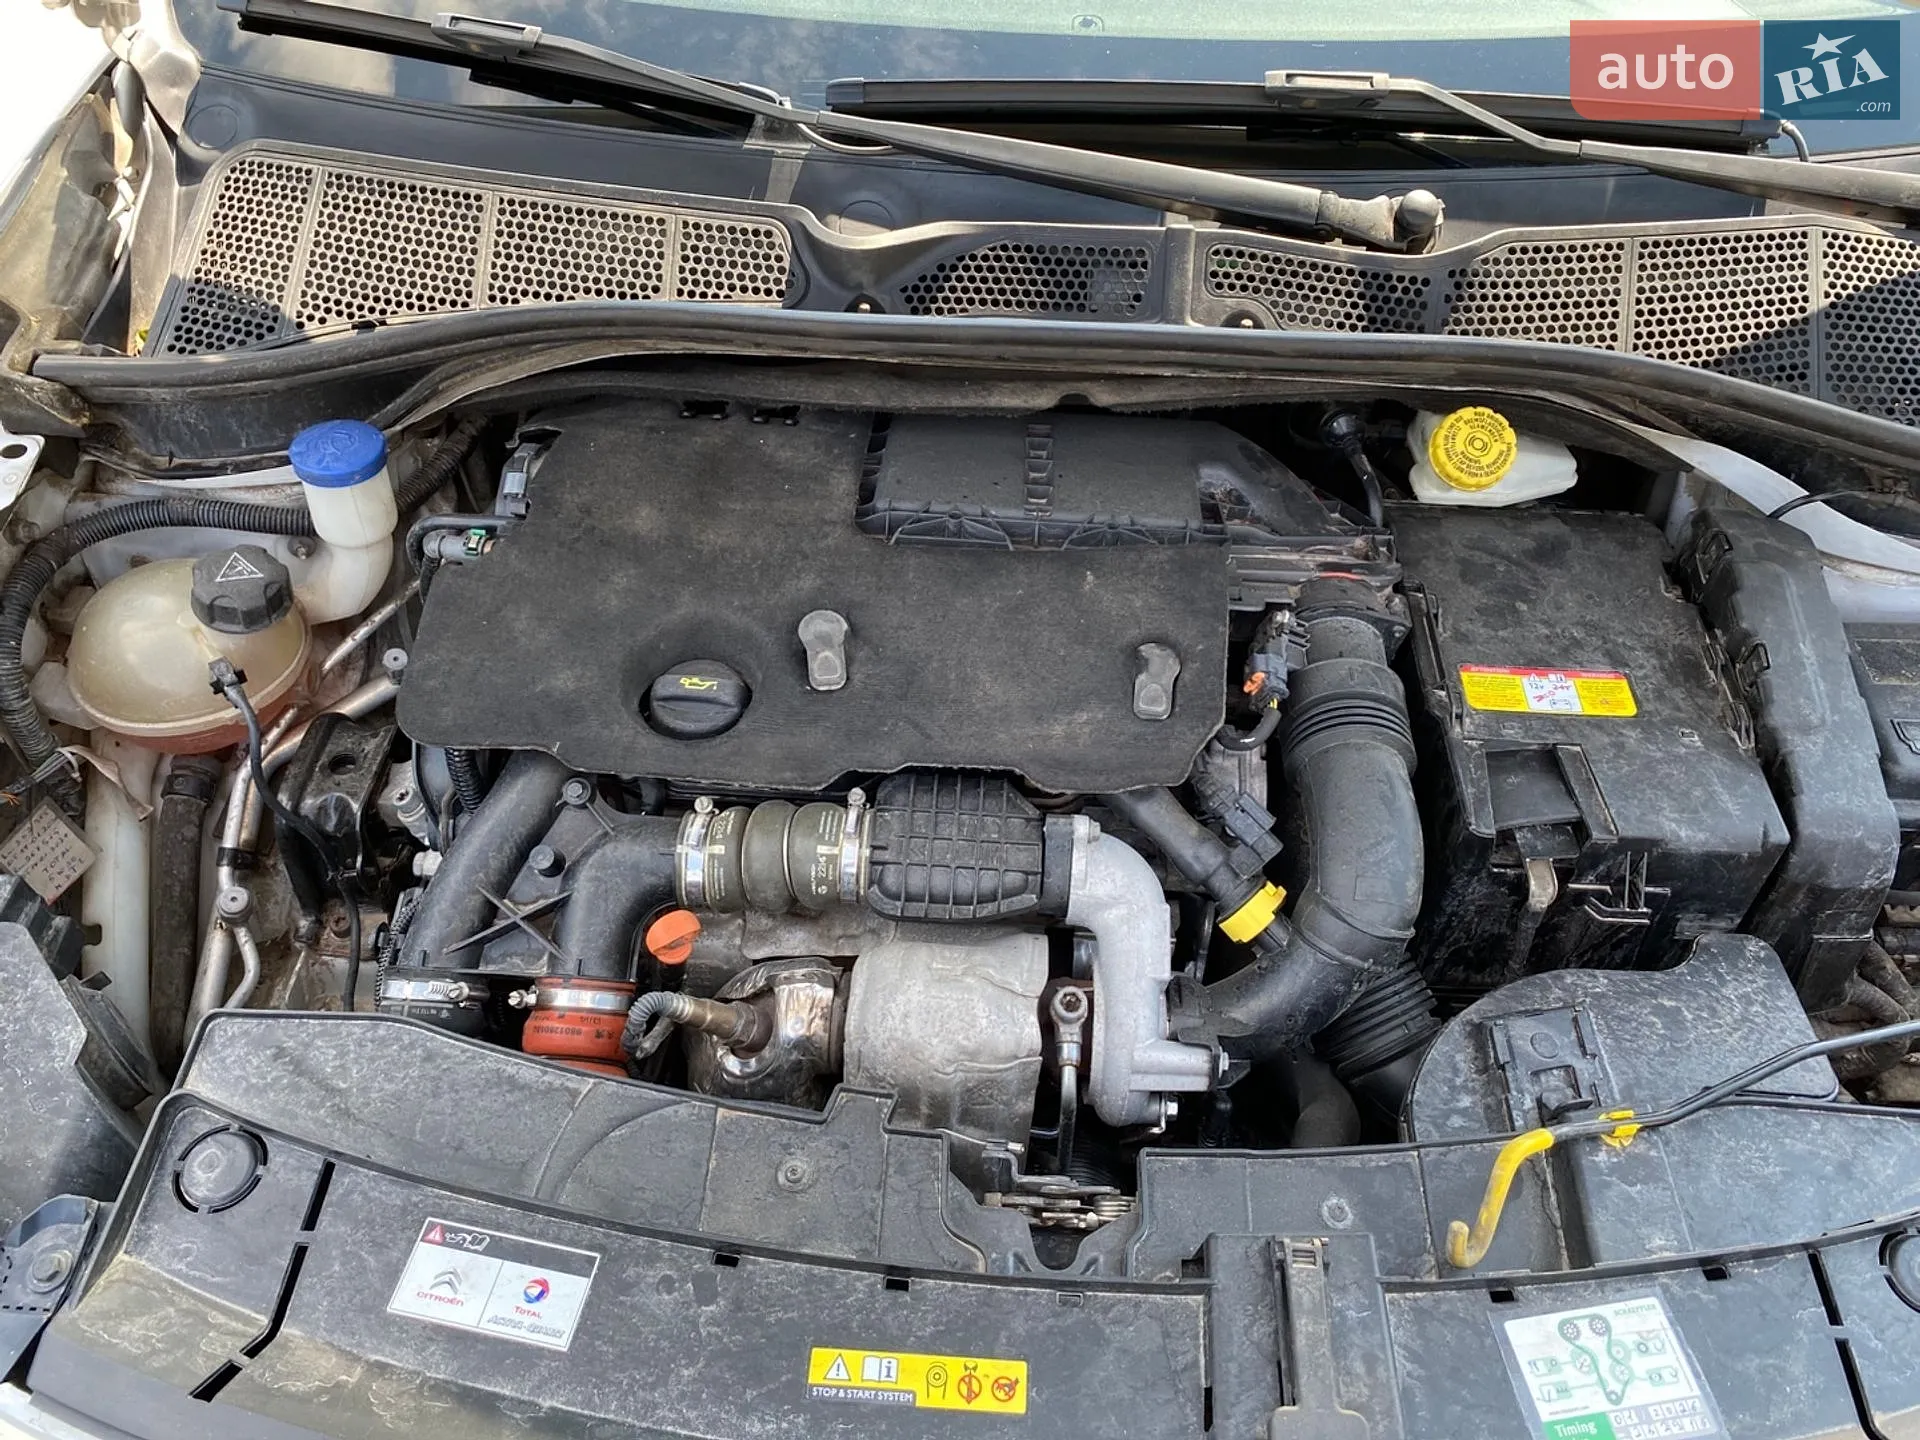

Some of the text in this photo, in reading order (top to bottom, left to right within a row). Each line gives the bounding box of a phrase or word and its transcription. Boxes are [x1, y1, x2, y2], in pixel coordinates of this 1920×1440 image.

[811, 1386, 914, 1402] STOP & START SYSTEM
[1553, 1421, 1598, 1438] Timing
